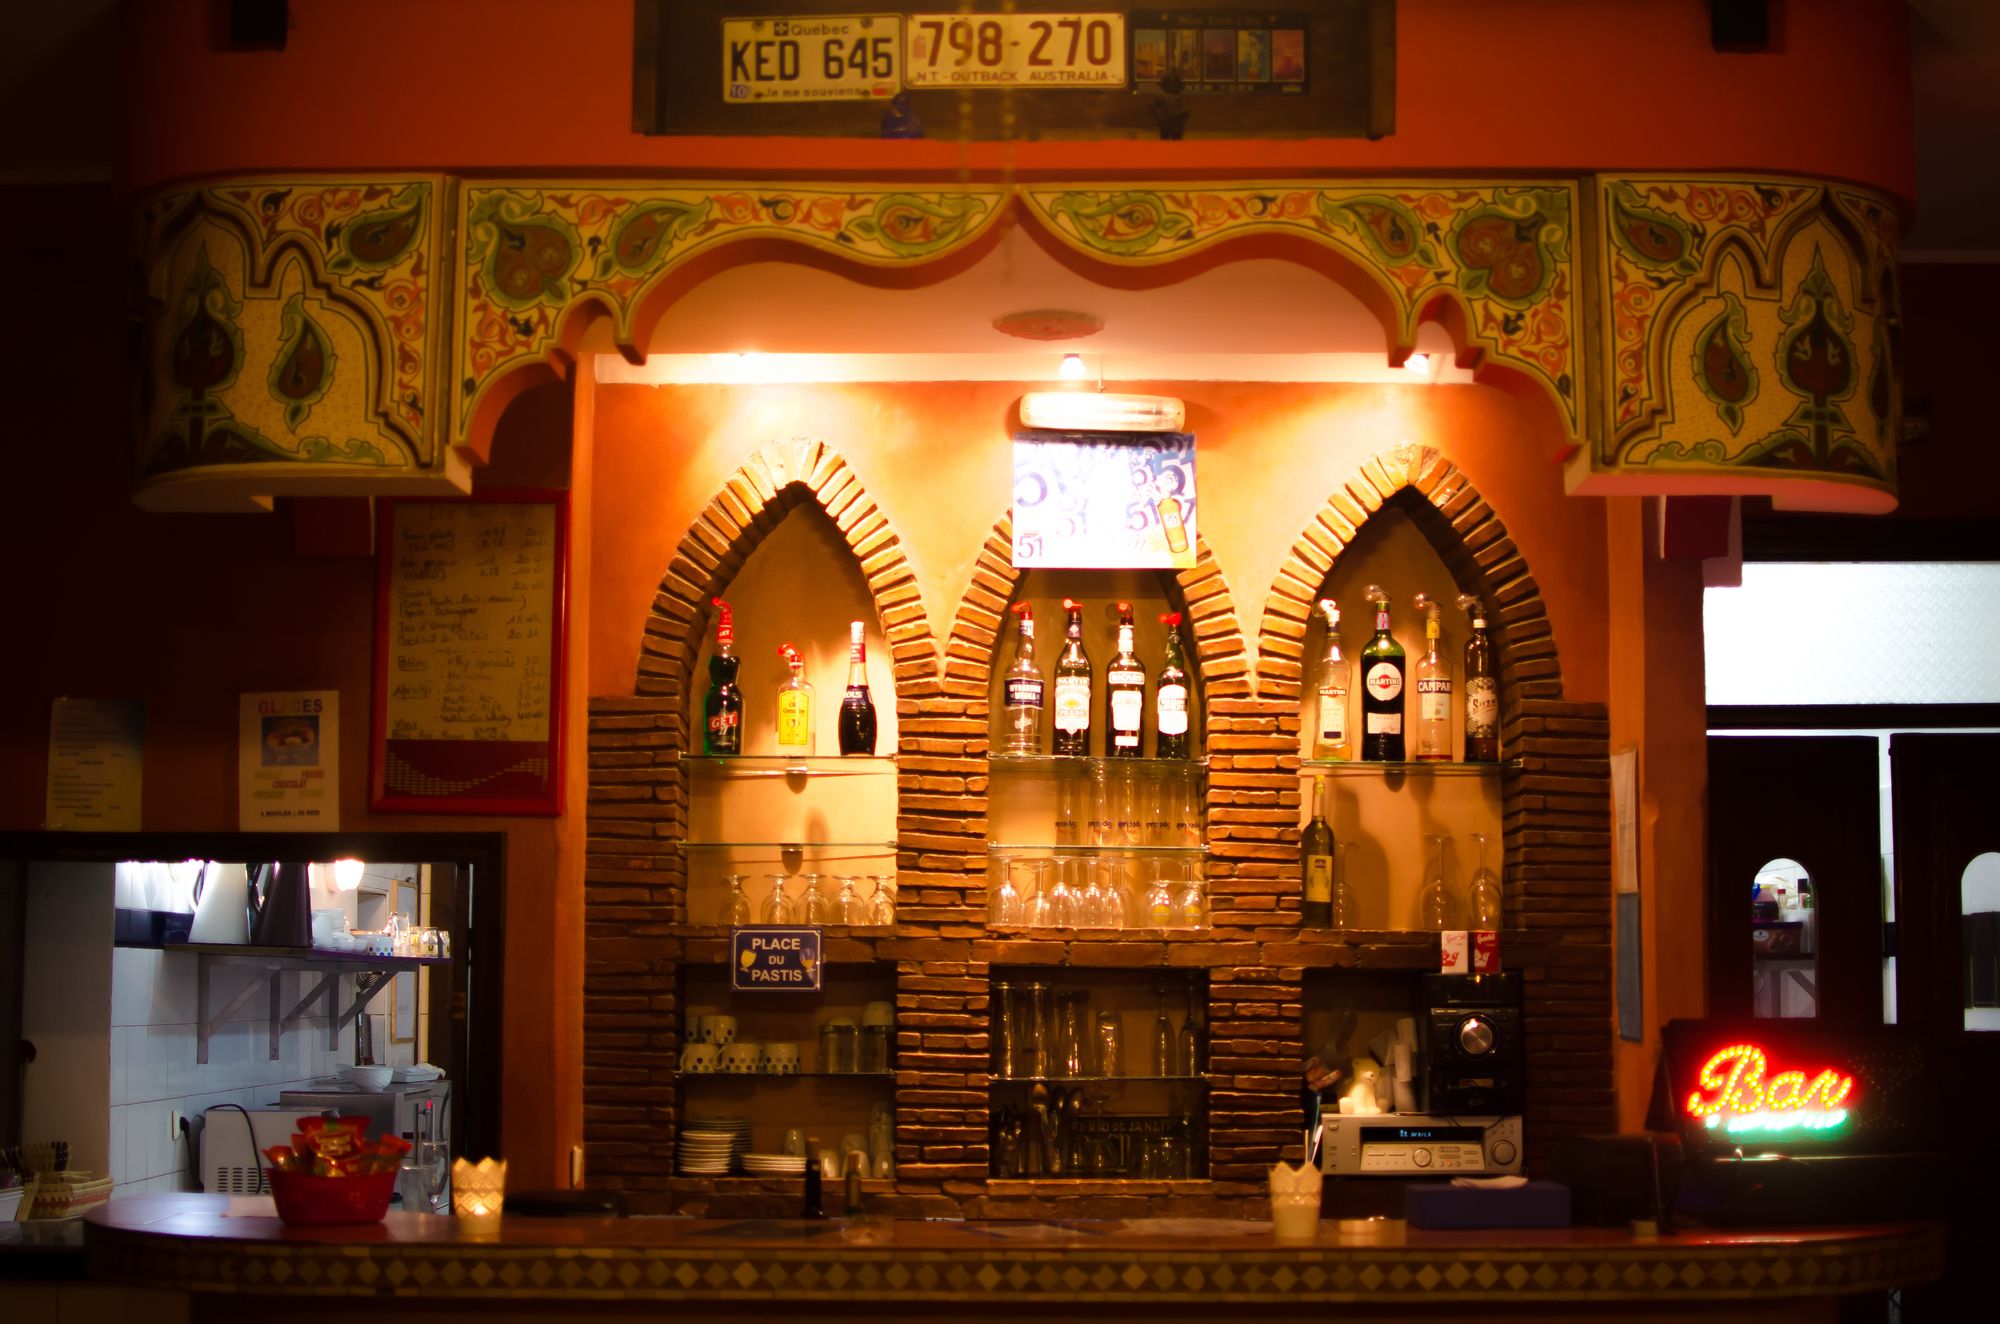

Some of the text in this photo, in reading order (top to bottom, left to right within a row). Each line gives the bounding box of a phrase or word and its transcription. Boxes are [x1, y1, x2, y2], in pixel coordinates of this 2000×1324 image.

[731, 37, 894, 82] KED 645
[950, 70, 1018, 82] OUTBACK
[1029, 70, 1108, 82] AUSTRALIA
[1017, 534, 1043, 559] 51
[1370, 678, 1400, 686] MARTINI
[1319, 688, 1346, 696] MARTINI
[711, 714, 736, 729] GET
[752, 938, 801, 950] PLACE
[768, 955, 785, 965] DU
[751, 969, 803, 982] PASTIS
[1686, 1044, 1853, 1117] Bar
